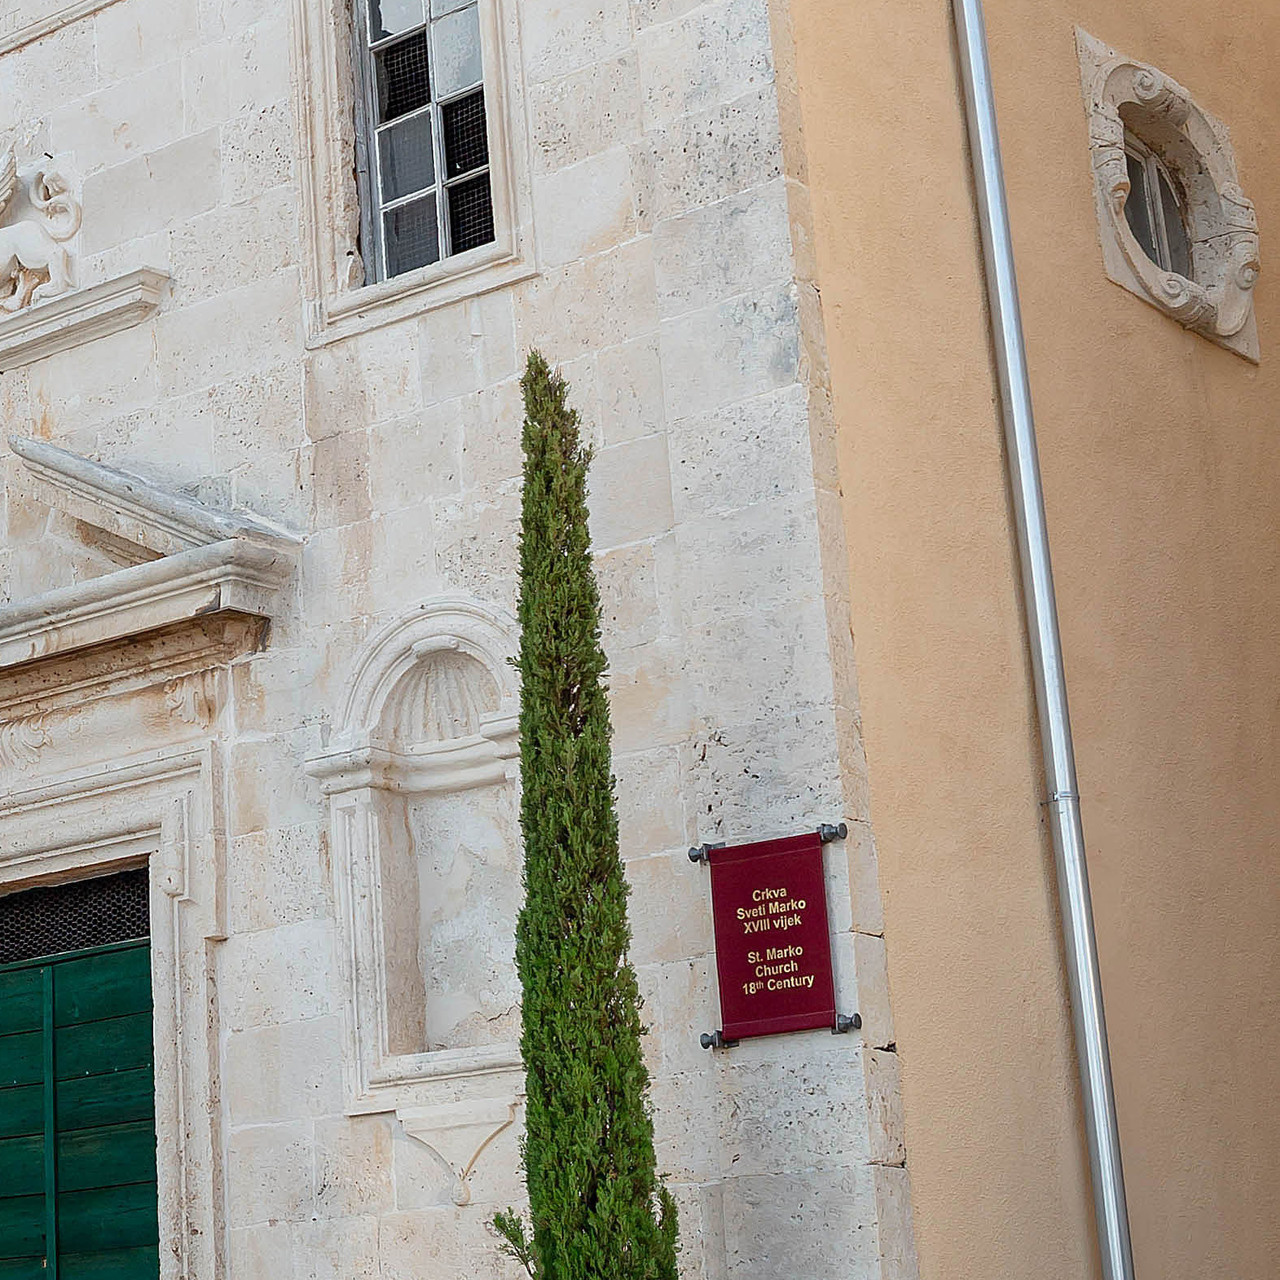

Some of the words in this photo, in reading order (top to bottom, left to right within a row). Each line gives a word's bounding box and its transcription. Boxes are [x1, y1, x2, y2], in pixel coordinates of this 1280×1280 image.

[752, 887, 787, 902] Crkva
[736, 905, 766, 920] Sveti
[768, 899, 807, 915] Marko
[743, 918, 770, 934] XVIII
[772, 914, 802, 931] vijek
[747, 951, 764, 964] St.
[766, 945, 804, 961] Marko
[755, 960, 799, 978] Church
[742, 980, 764, 995] 18th
[767, 974, 815, 991] Century
